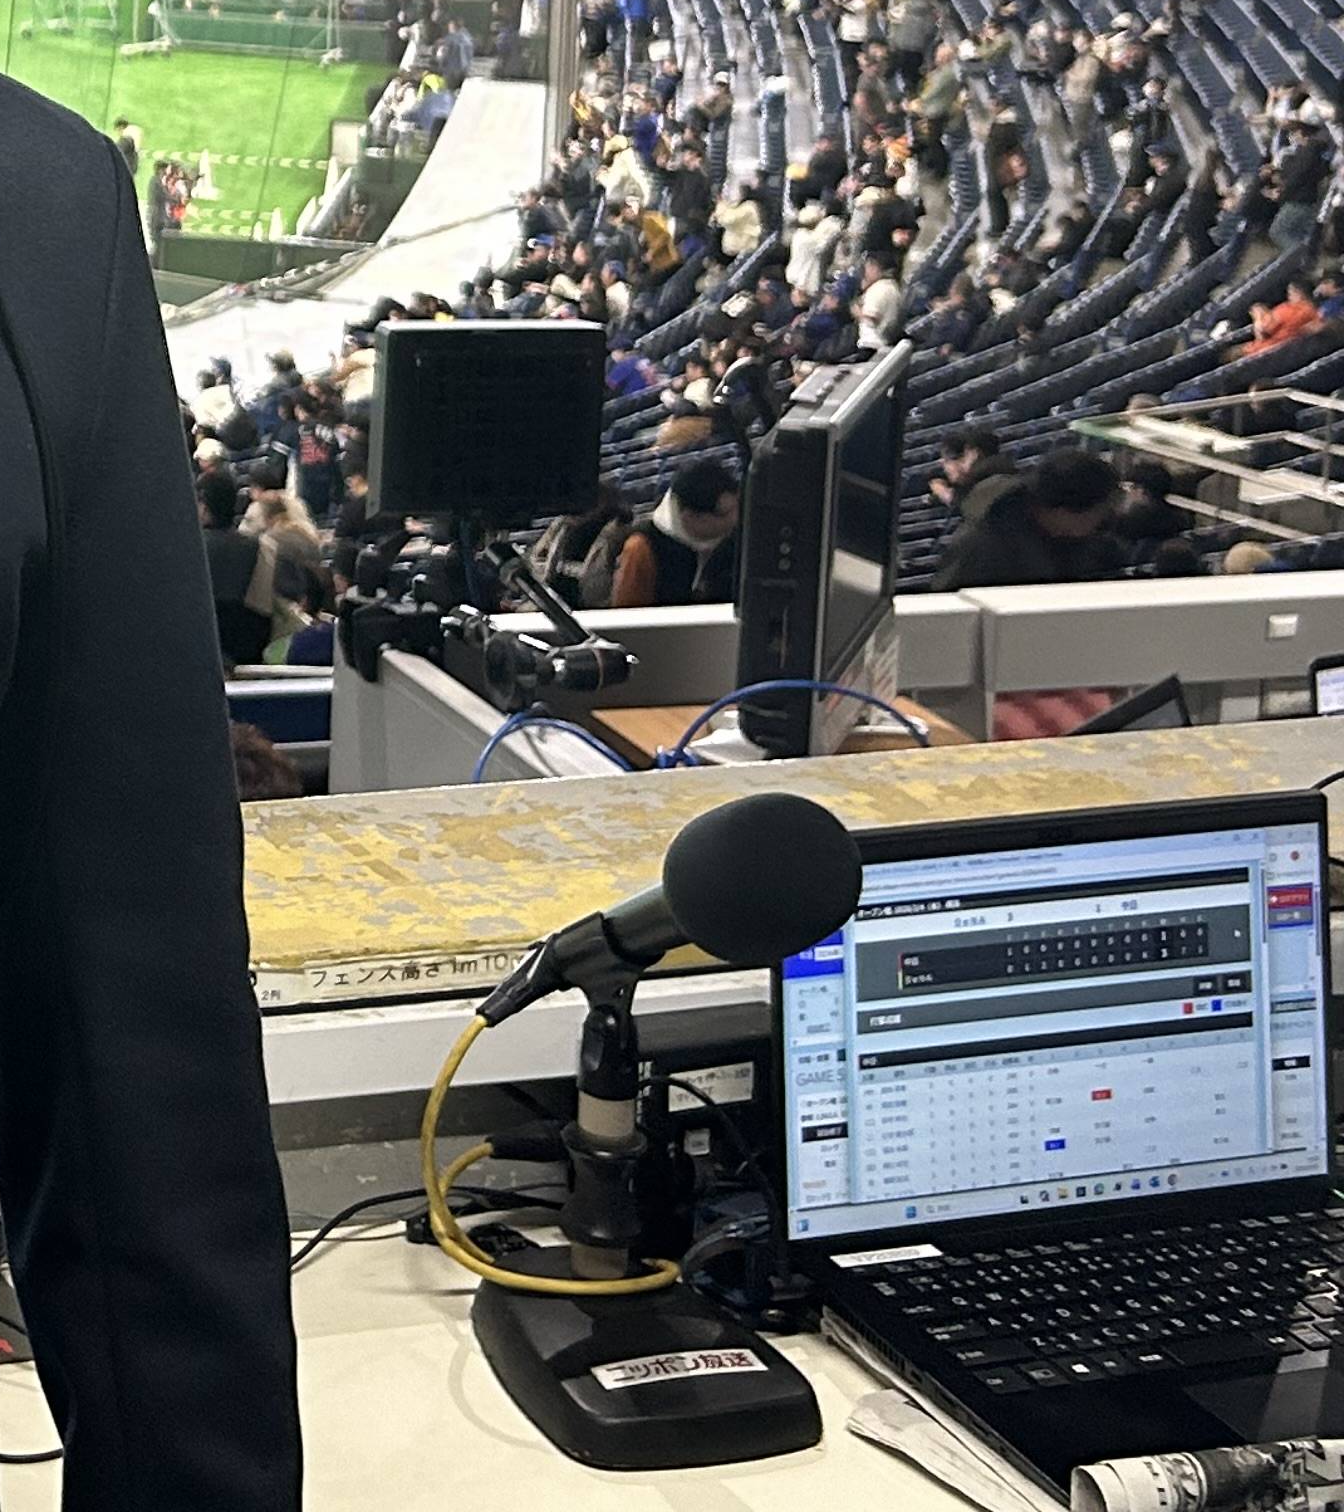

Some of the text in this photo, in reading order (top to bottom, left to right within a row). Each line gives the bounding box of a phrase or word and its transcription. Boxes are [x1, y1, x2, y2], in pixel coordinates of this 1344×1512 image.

[606, 1352, 754, 1383] ニッポン放送
